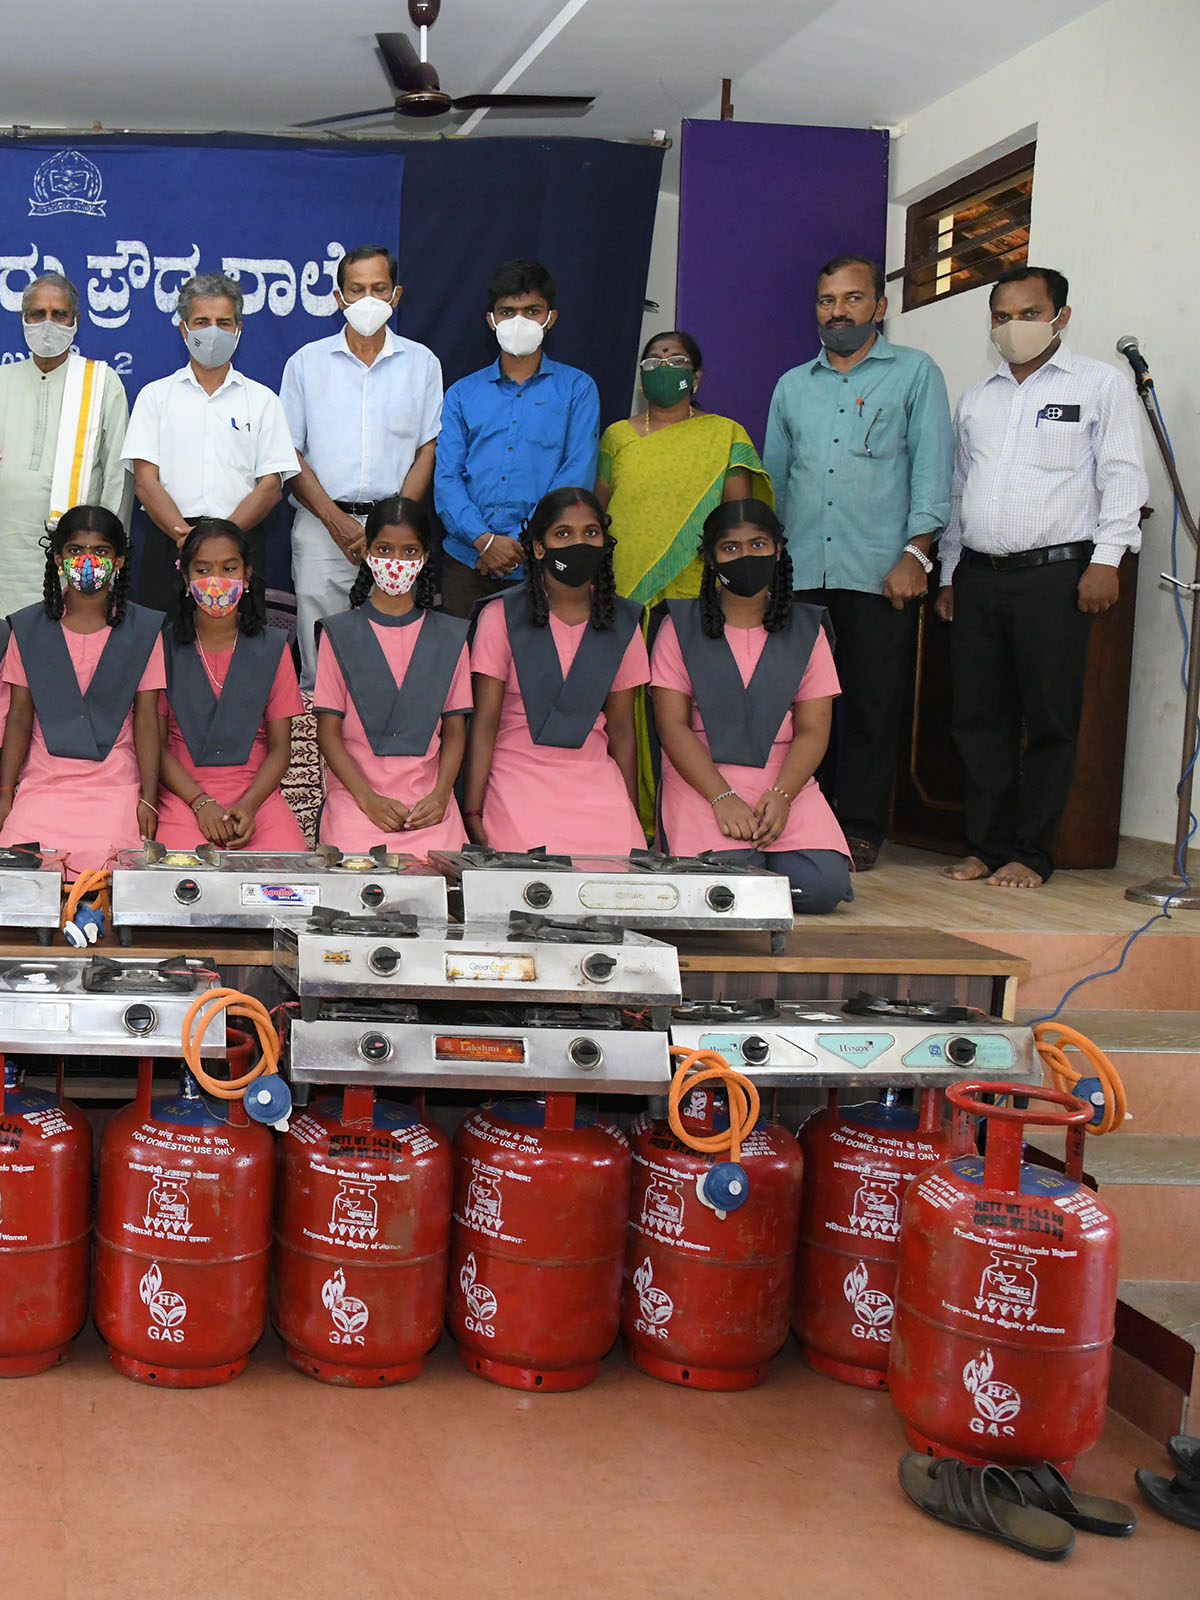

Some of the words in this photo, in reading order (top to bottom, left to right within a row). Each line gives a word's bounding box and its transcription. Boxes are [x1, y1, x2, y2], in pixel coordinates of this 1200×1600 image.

[114, 352, 133, 374] 2
[460, 1044, 500, 1052] Lakshmi
[131, 1130, 147, 1142] FOR
[146, 1137, 192, 1153] DOMESTIC
[193, 1146, 212, 1155] USE
[214, 1147, 235, 1156] ONLY
[329, 1135, 351, 1145] NETT
[354, 1136, 370, 1146] WT.
[373, 1137, 390, 1148] 14.2
[468, 1125, 499, 1144] DOMESTIC
[500, 1138, 517, 1150] USE
[518, 1143, 543, 1155] ONLY
[830, 1132, 846, 1144] FOR
[846, 1139, 894, 1156] DOMESTIC
[896, 1149, 916, 1160] USE
[918, 1152, 940, 1161] ONLY
[975, 1200, 1002, 1213] NETT
[1005, 1202, 1026, 1217] WT.
[1051, 1211, 1064, 1227] kg
[953, 1227, 987, 1245] Pradhan
[988, 1237, 1016, 1251] Mantri
[1018, 1243, 1049, 1256] Ujjwala
[1051, 1224, 1064, 1241] kg
[335, 1236, 345, 1246] the
[346, 1239, 369, 1250] dignity
[370, 1241, 378, 1250] of
[158, 1294, 180, 1306] HP
[472, 1286, 491, 1300] HP
[648, 1291, 667, 1305] HP
[864, 1293, 887, 1306] HP
[341, 1301, 363, 1313] HP
[465, 1316, 495, 1338] GAS
[982, 1313, 995, 1324] the
[996, 1317, 1025, 1332] dignity
[1026, 1323, 1036, 1332] of
[147, 1325, 185, 1343] GAS
[852, 1323, 891, 1342] GAS
[986, 1384, 1012, 1400] HP
[969, 1417, 1016, 1437] GAS
